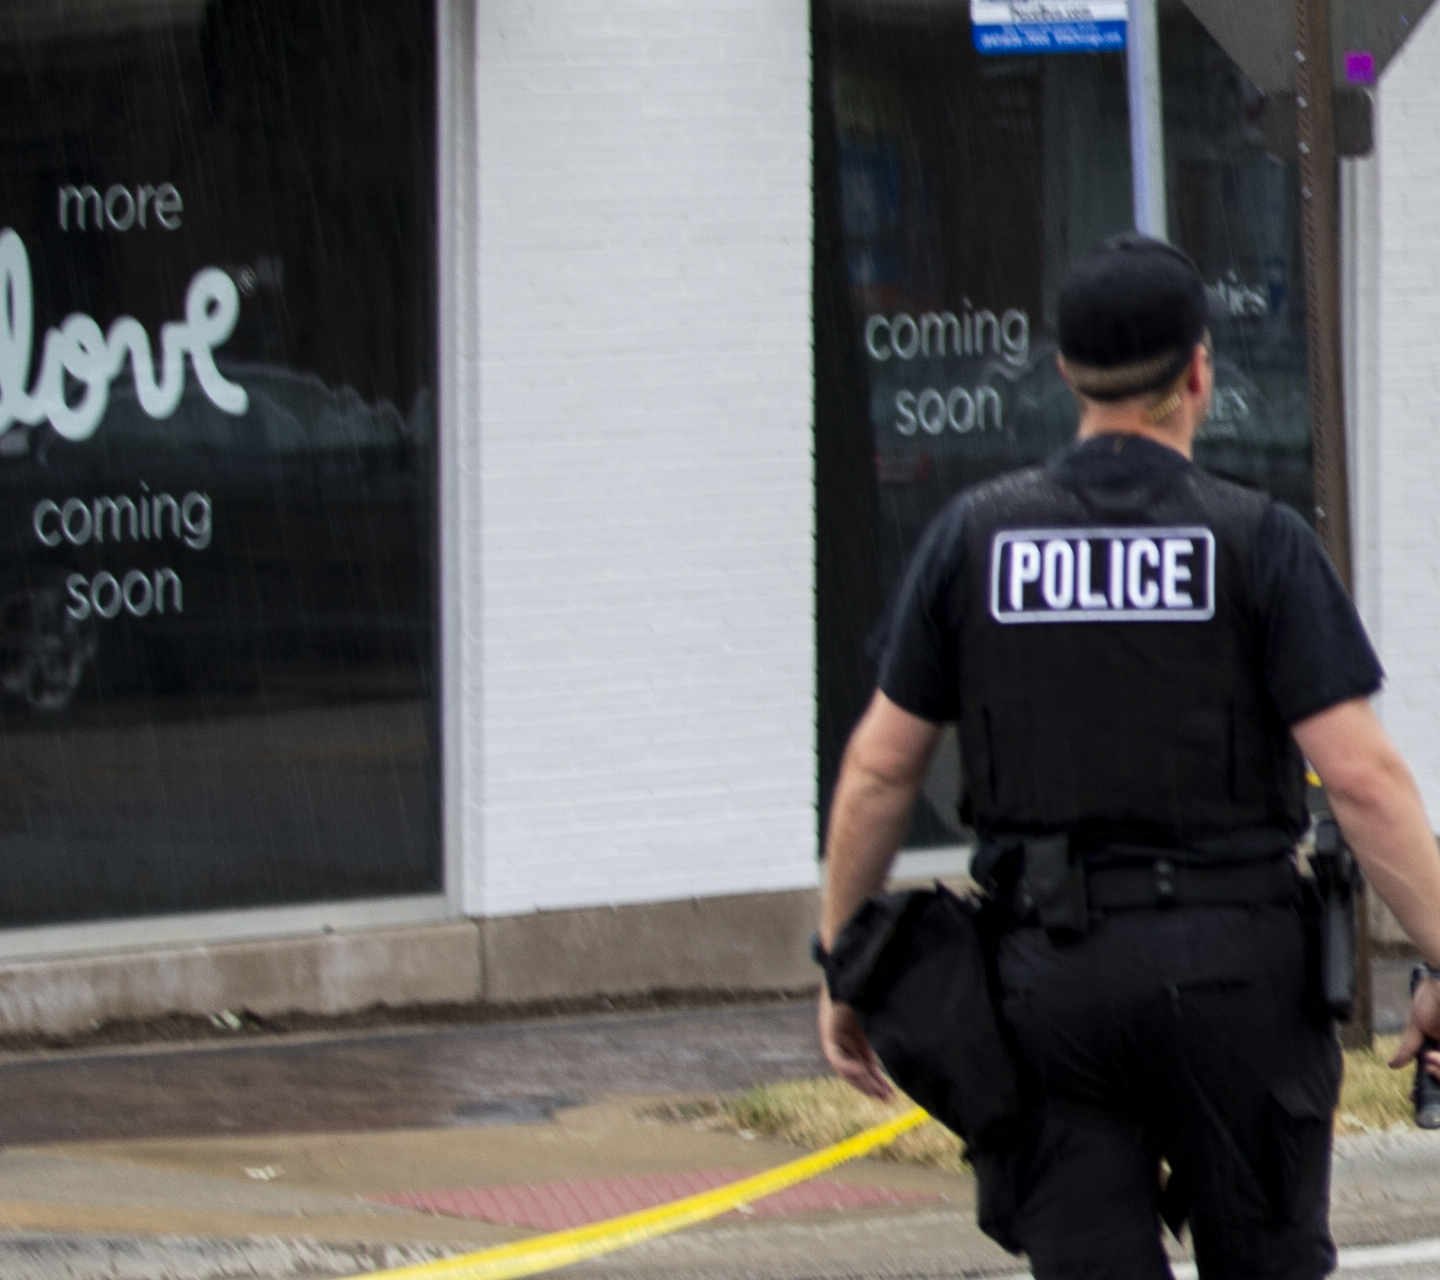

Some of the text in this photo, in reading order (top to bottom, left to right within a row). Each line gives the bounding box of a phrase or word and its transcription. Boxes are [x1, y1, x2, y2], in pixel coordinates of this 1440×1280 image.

[58, 182, 184, 231] more
[0, 227, 249, 442] love
[865, 297, 1030, 368] coming
[893, 379, 1003, 437] soon
[32, 481, 213, 549] coming
[64, 566, 184, 620] soon
[1008, 535, 1195, 610] POLICE
